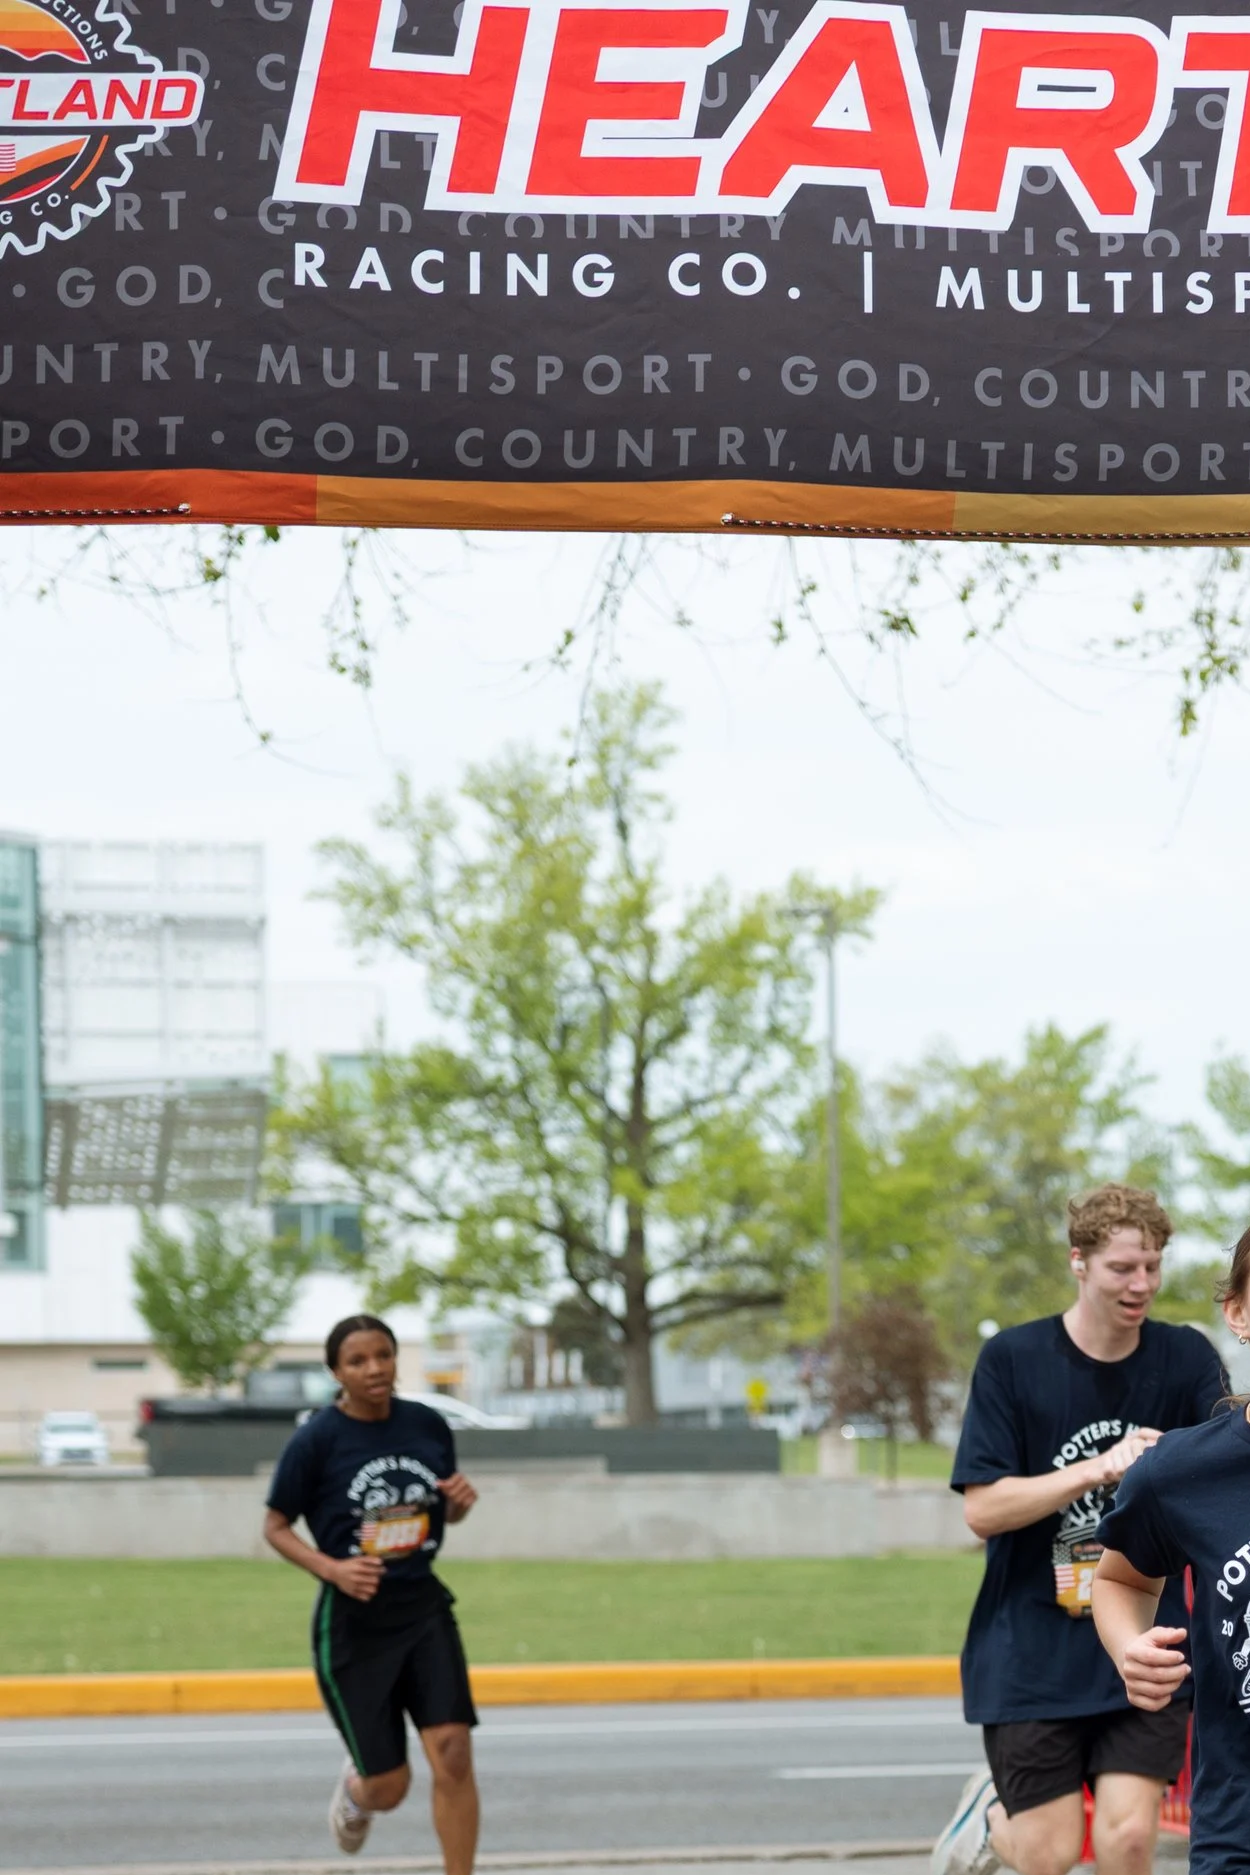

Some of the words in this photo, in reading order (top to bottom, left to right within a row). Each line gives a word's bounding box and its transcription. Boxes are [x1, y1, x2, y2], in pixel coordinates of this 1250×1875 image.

[42, 0, 109, 60] CTIONS
[30, 191, 70, 217] CO.
[57, 265, 221, 308] GOD,
[295, 243, 614, 297] RACING
[668, 253, 800, 299] CO.
[257, 344, 712, 395] MULTISPORT
[781, 356, 939, 406] GOD,
[256, 418, 418, 467] GOD,
[456, 427, 795, 470] COUNTRY,
[1221, 1619, 1234, 1637] 20
